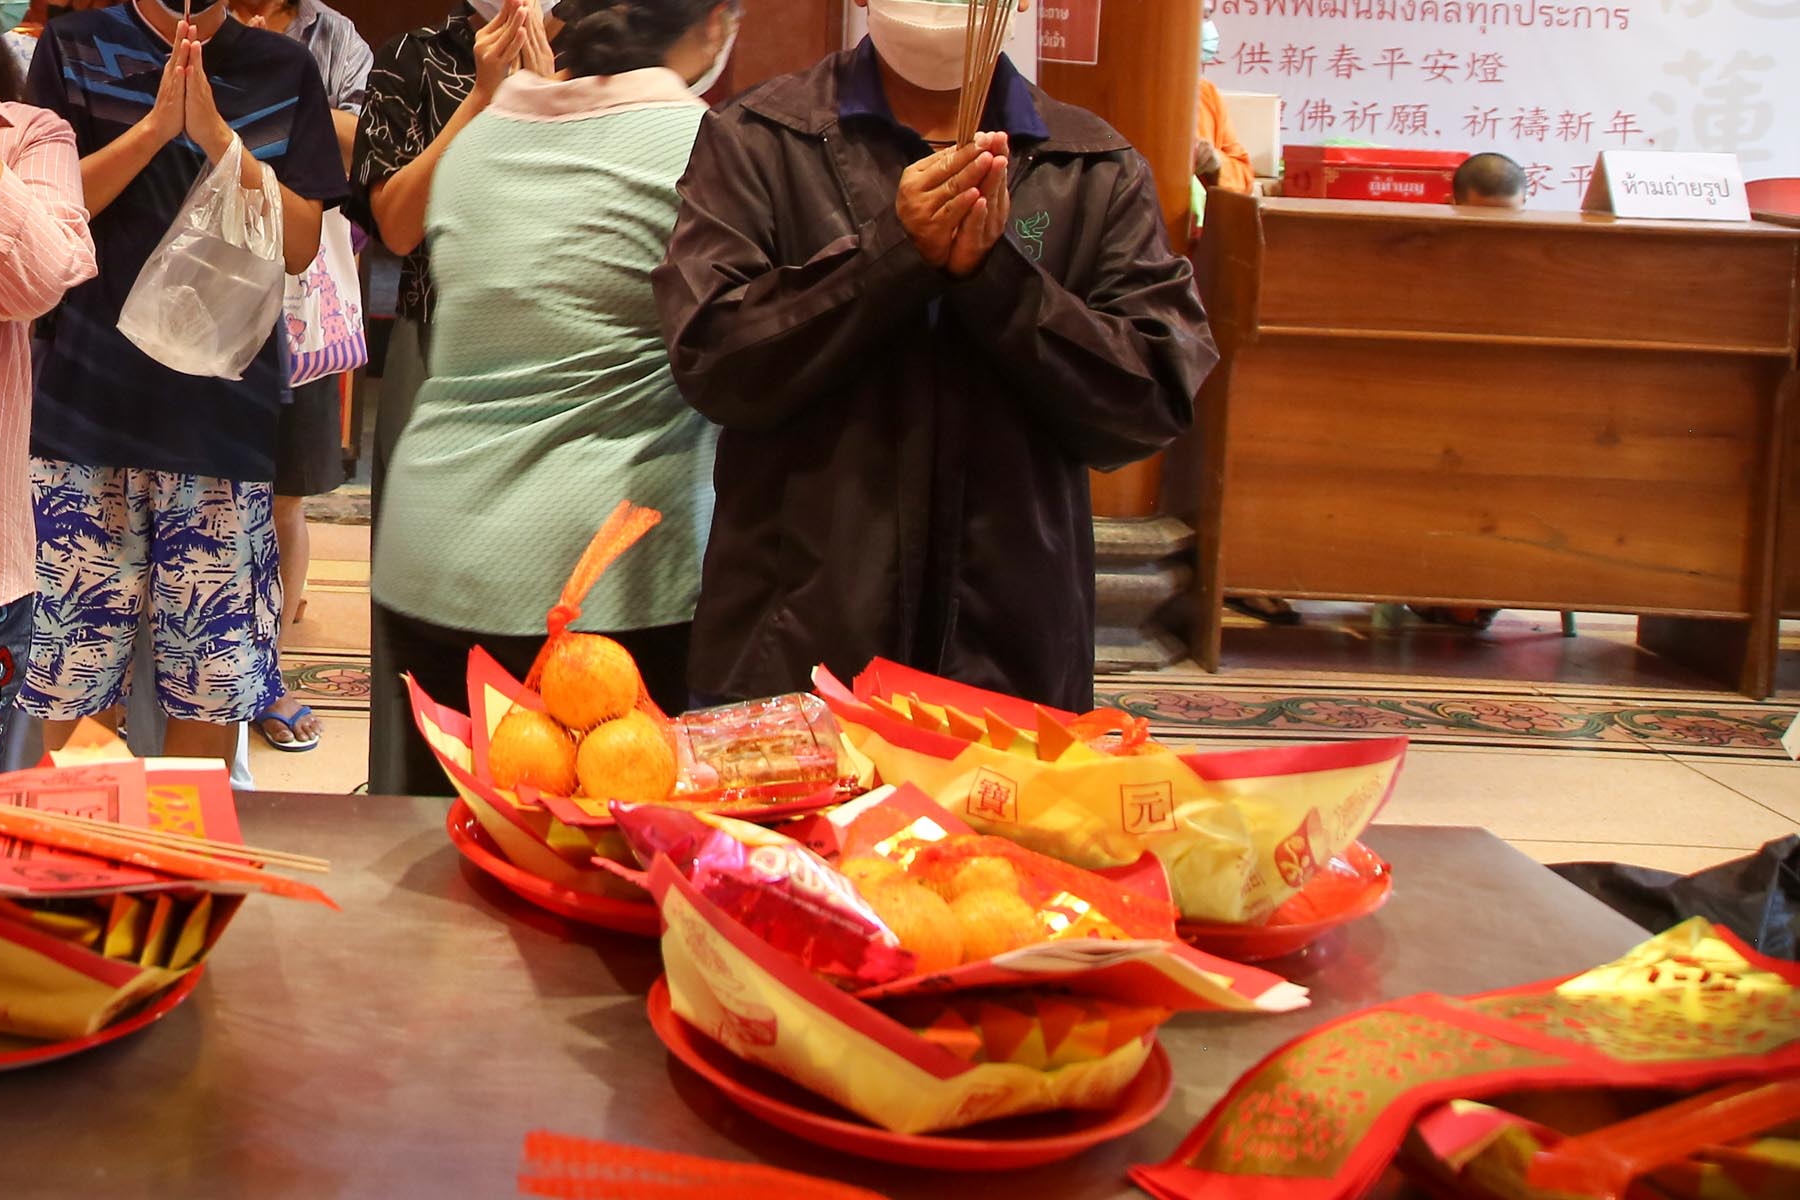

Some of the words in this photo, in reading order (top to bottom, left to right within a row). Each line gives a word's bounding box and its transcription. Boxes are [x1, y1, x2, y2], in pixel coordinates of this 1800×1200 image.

[1622, 171, 1730, 205] ห้ามถ่ายรูป
[1130, 792, 1168, 827] 元
